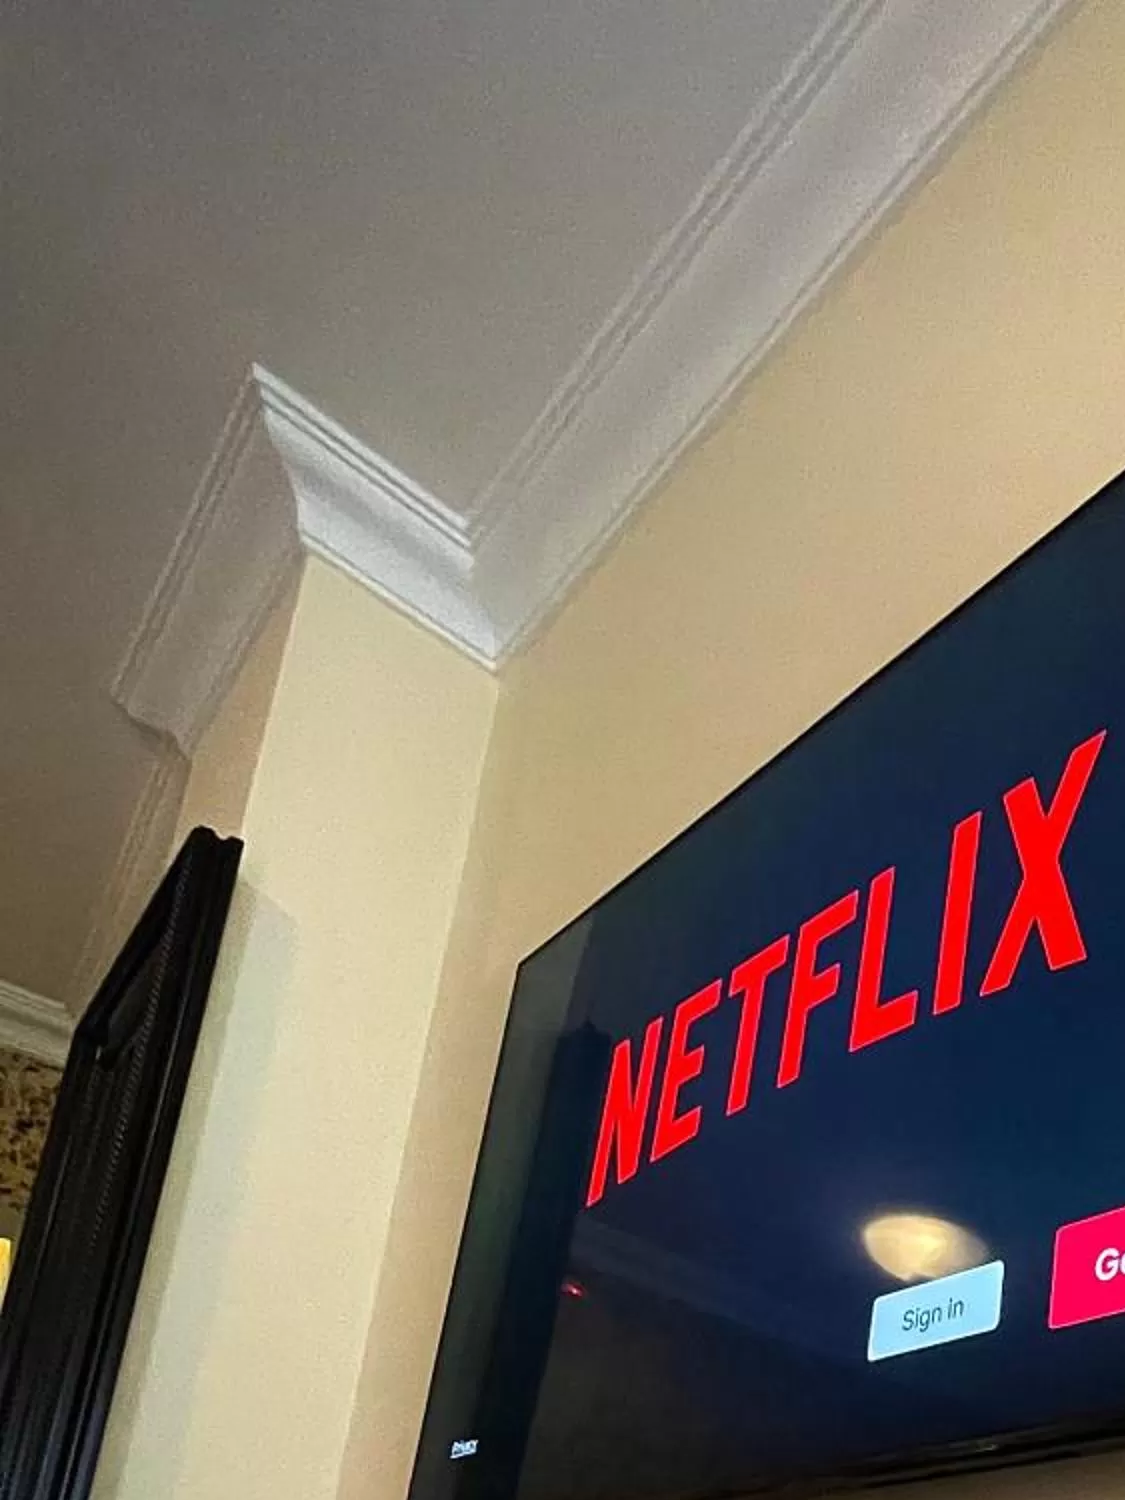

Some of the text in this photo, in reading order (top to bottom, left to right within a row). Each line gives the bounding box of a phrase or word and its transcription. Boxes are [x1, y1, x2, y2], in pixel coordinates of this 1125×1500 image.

[587, 730, 1106, 1207] NETFLIX
[902, 1297, 965, 1333] Sign in
